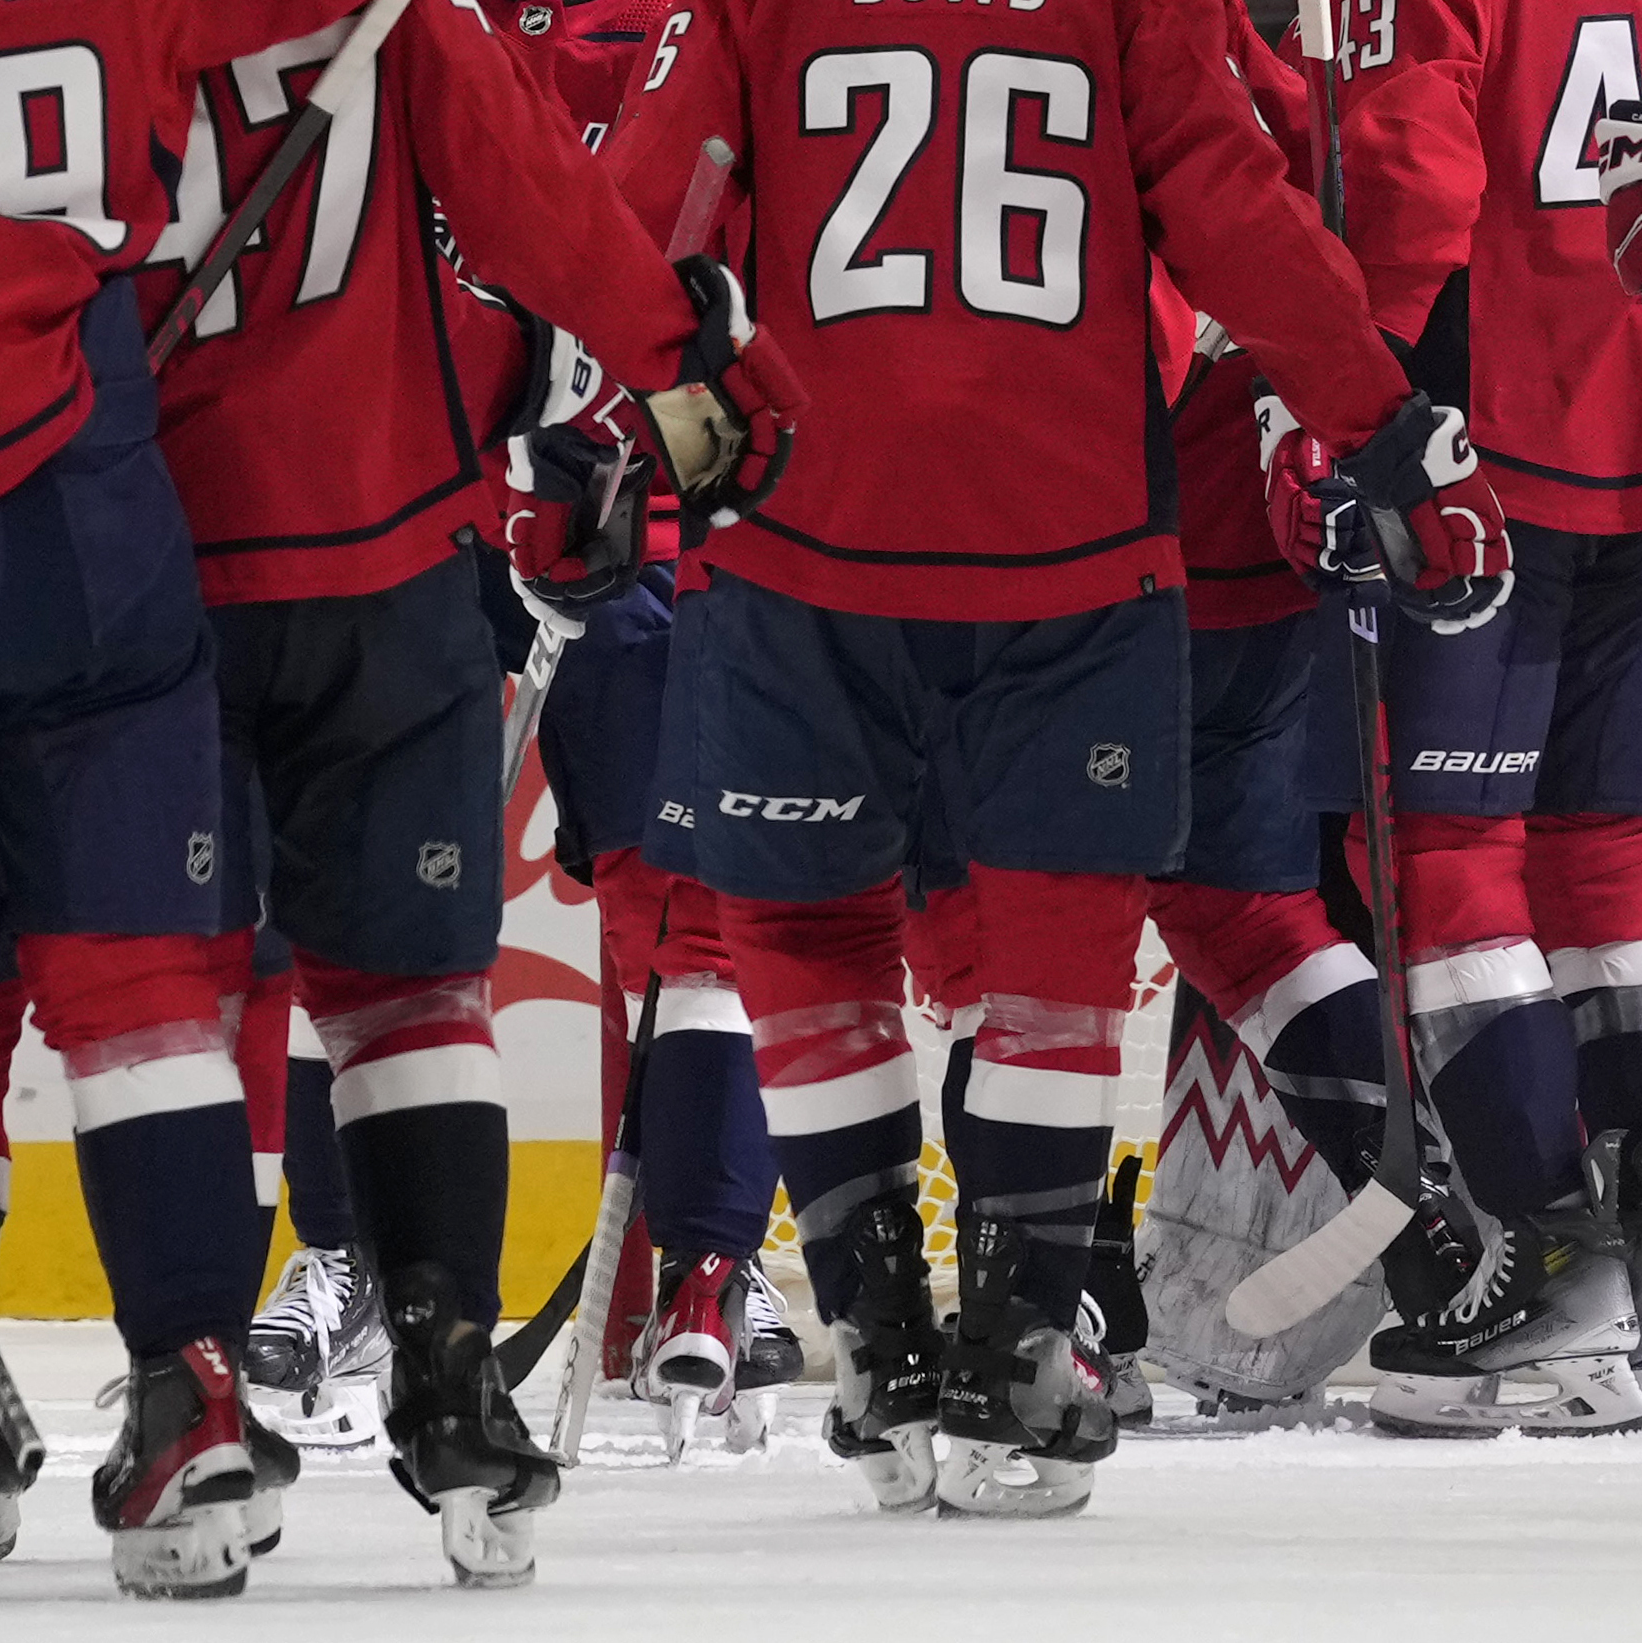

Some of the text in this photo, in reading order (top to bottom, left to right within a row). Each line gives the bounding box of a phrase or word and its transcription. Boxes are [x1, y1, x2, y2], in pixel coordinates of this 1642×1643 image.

[799, 47, 1094, 330] 26
[1409, 751, 1541, 774] BAUER
[720, 789, 867, 822] CCM
[1455, 1309, 1528, 1357] BAUER
